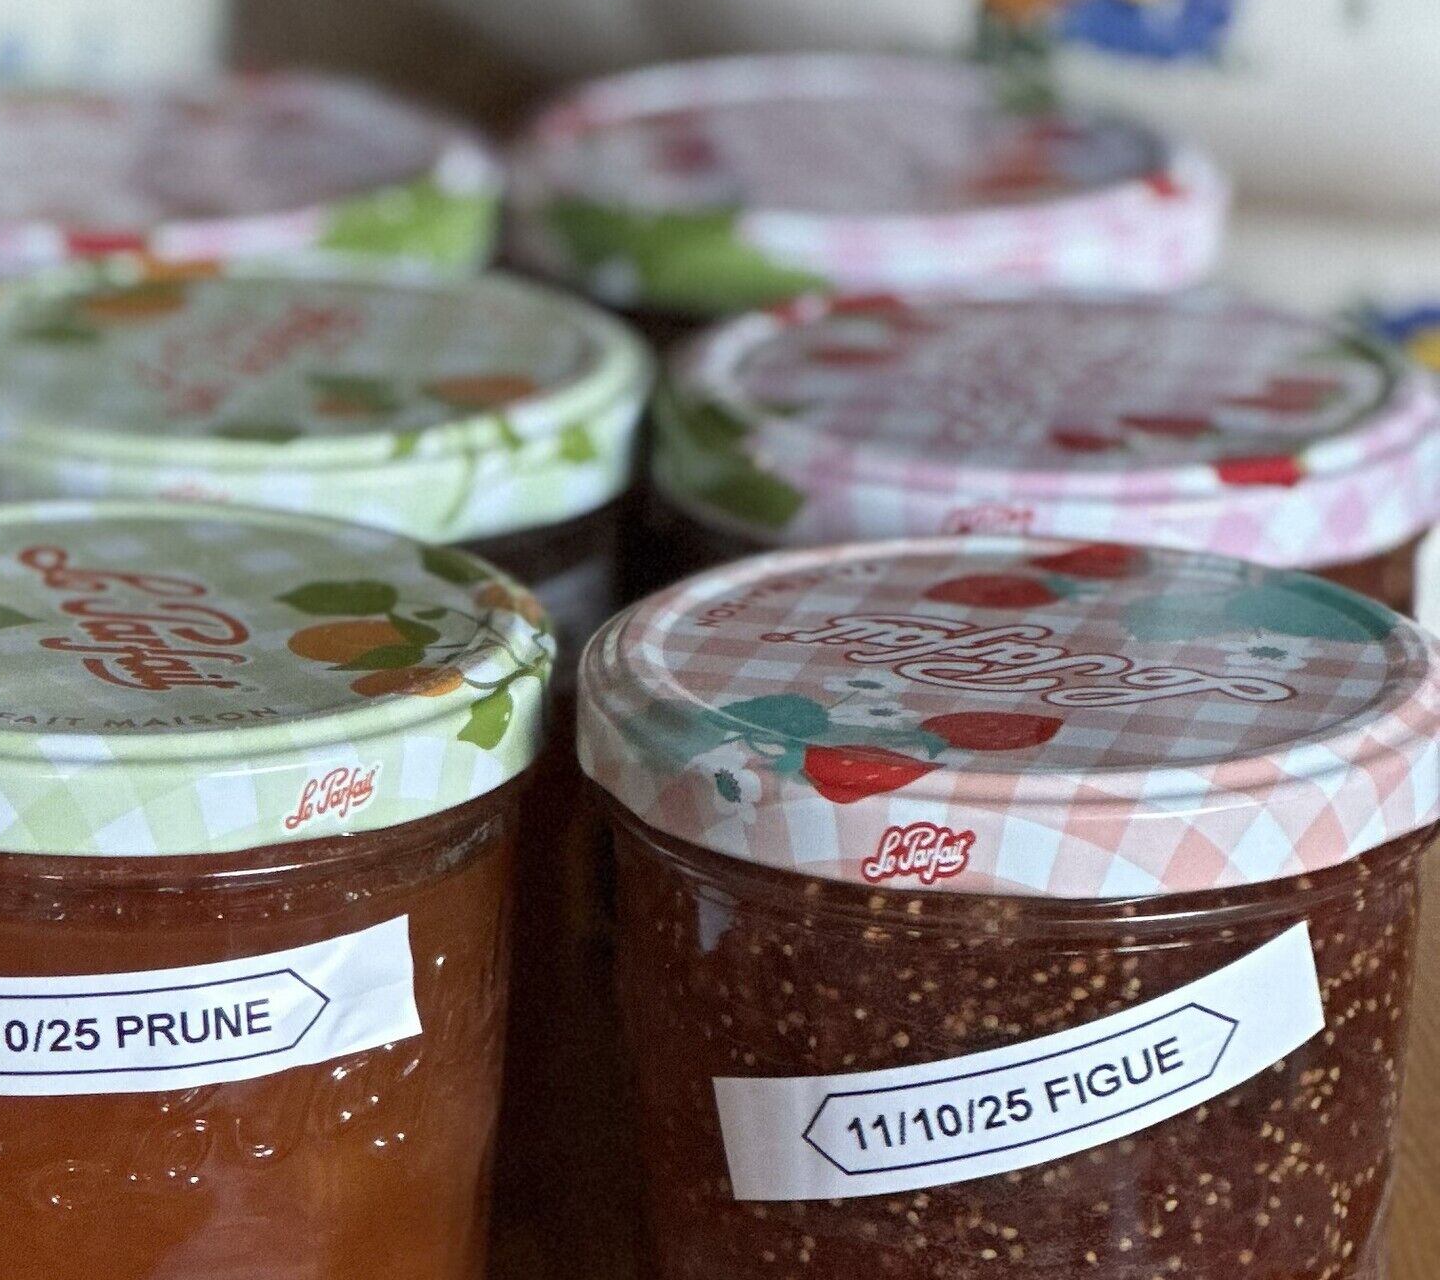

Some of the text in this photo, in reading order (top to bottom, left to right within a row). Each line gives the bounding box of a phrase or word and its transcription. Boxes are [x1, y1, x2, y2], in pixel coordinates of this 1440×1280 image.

[18, 545, 208, 596] Le
[285, 778, 318, 829] Le
[864, 828, 900, 877] Le
[116, 997, 272, 1049] PRUNE
[847, 1035, 1185, 1151] 11/10/25 FIGUE
